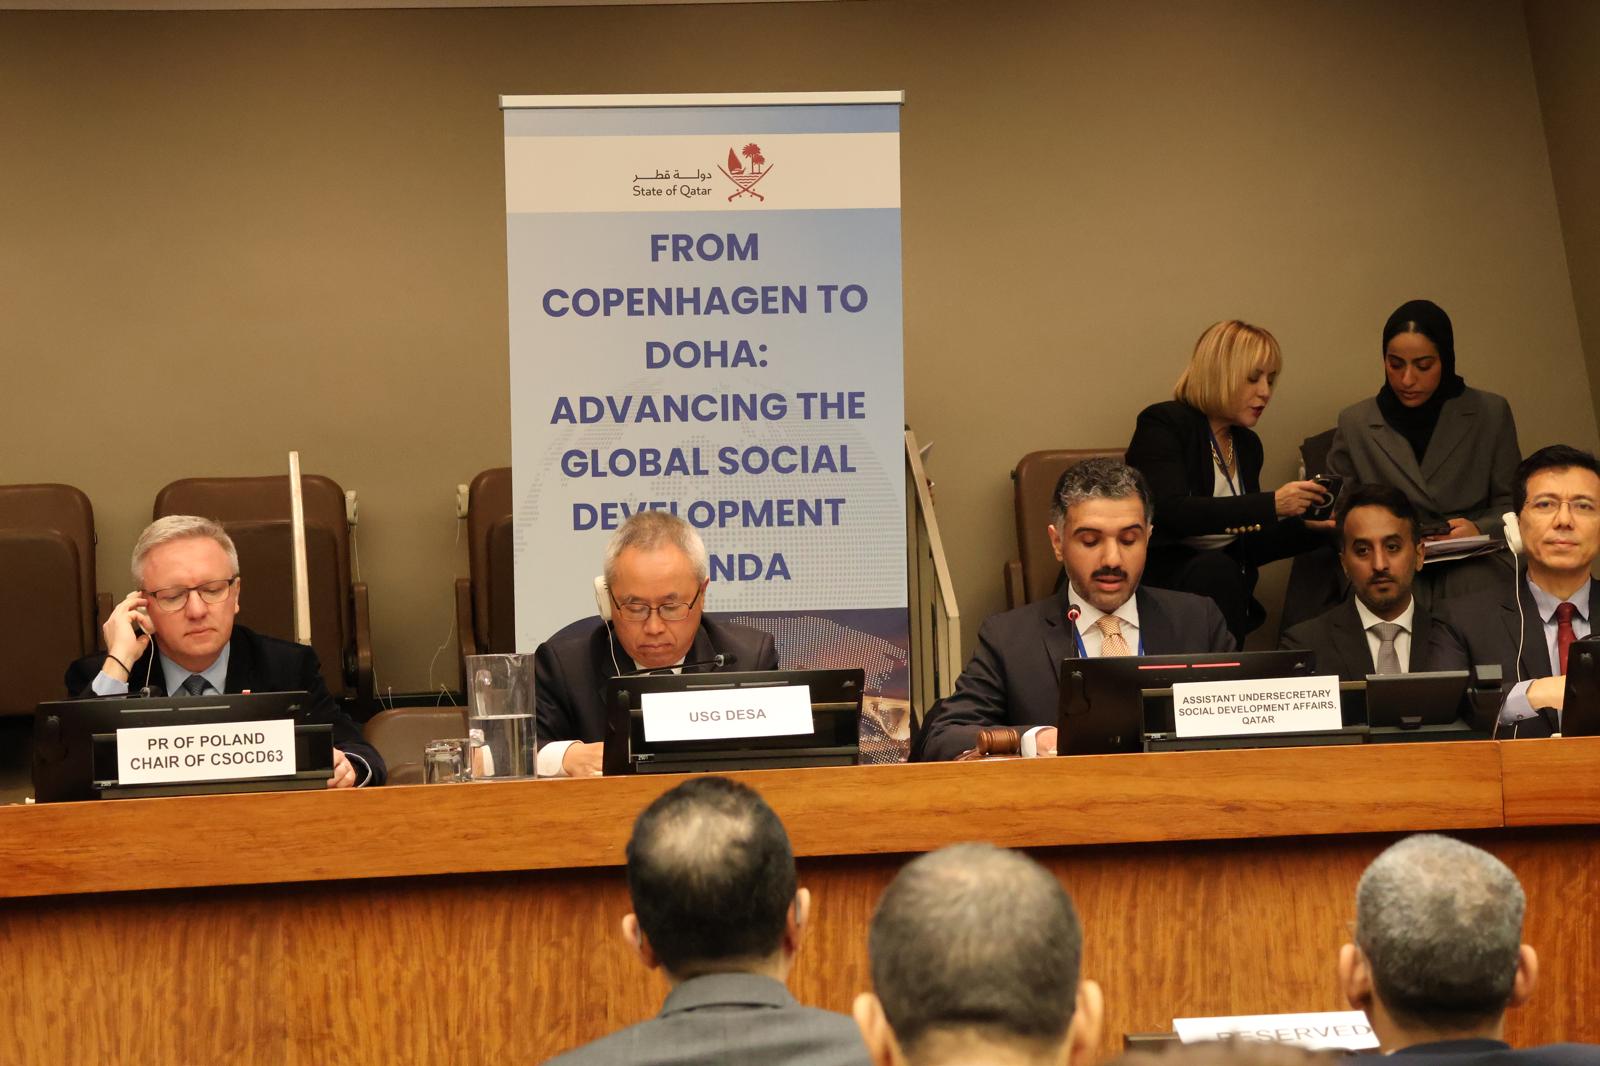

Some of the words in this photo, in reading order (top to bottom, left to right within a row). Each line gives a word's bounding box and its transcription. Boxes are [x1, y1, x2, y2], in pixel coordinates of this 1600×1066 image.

[633, 169, 670, 182] قطر
[673, 169, 712, 182] دولة
[632, 185, 663, 197] State
[665, 184, 677, 196] of
[680, 184, 712, 198] Qatar
[650, 233, 759, 262] FROM
[542, 286, 807, 318] COPENHAGEN
[817, 284, 869, 313] TO
[645, 340, 768, 369] DOHA:
[550, 393, 788, 424] ADVANCING
[797, 391, 865, 420] THE
[560, 448, 709, 478] GLOBAL
[718, 445, 856, 475] SOCIAL
[709, 553, 791, 582] NDA
[1182, 694, 1236, 705] ASSISTANT
[1239, 689, 1331, 702] UNDERSECRETARY
[689, 710, 721, 722] USG
[726, 709, 766, 720] DESA
[1178, 706, 1215, 717] SOCIAL
[1217, 703, 1290, 715] DEVELOPMENT
[1242, 715, 1275, 725] QATAR
[148, 738, 169, 750] PR
[174, 737, 195, 749] OF
[200, 732, 265, 747] POLAND
[130, 755, 180, 770] CHAIR
[184, 754, 205, 767] OF
[210, 750, 284, 765] CSOCD63
